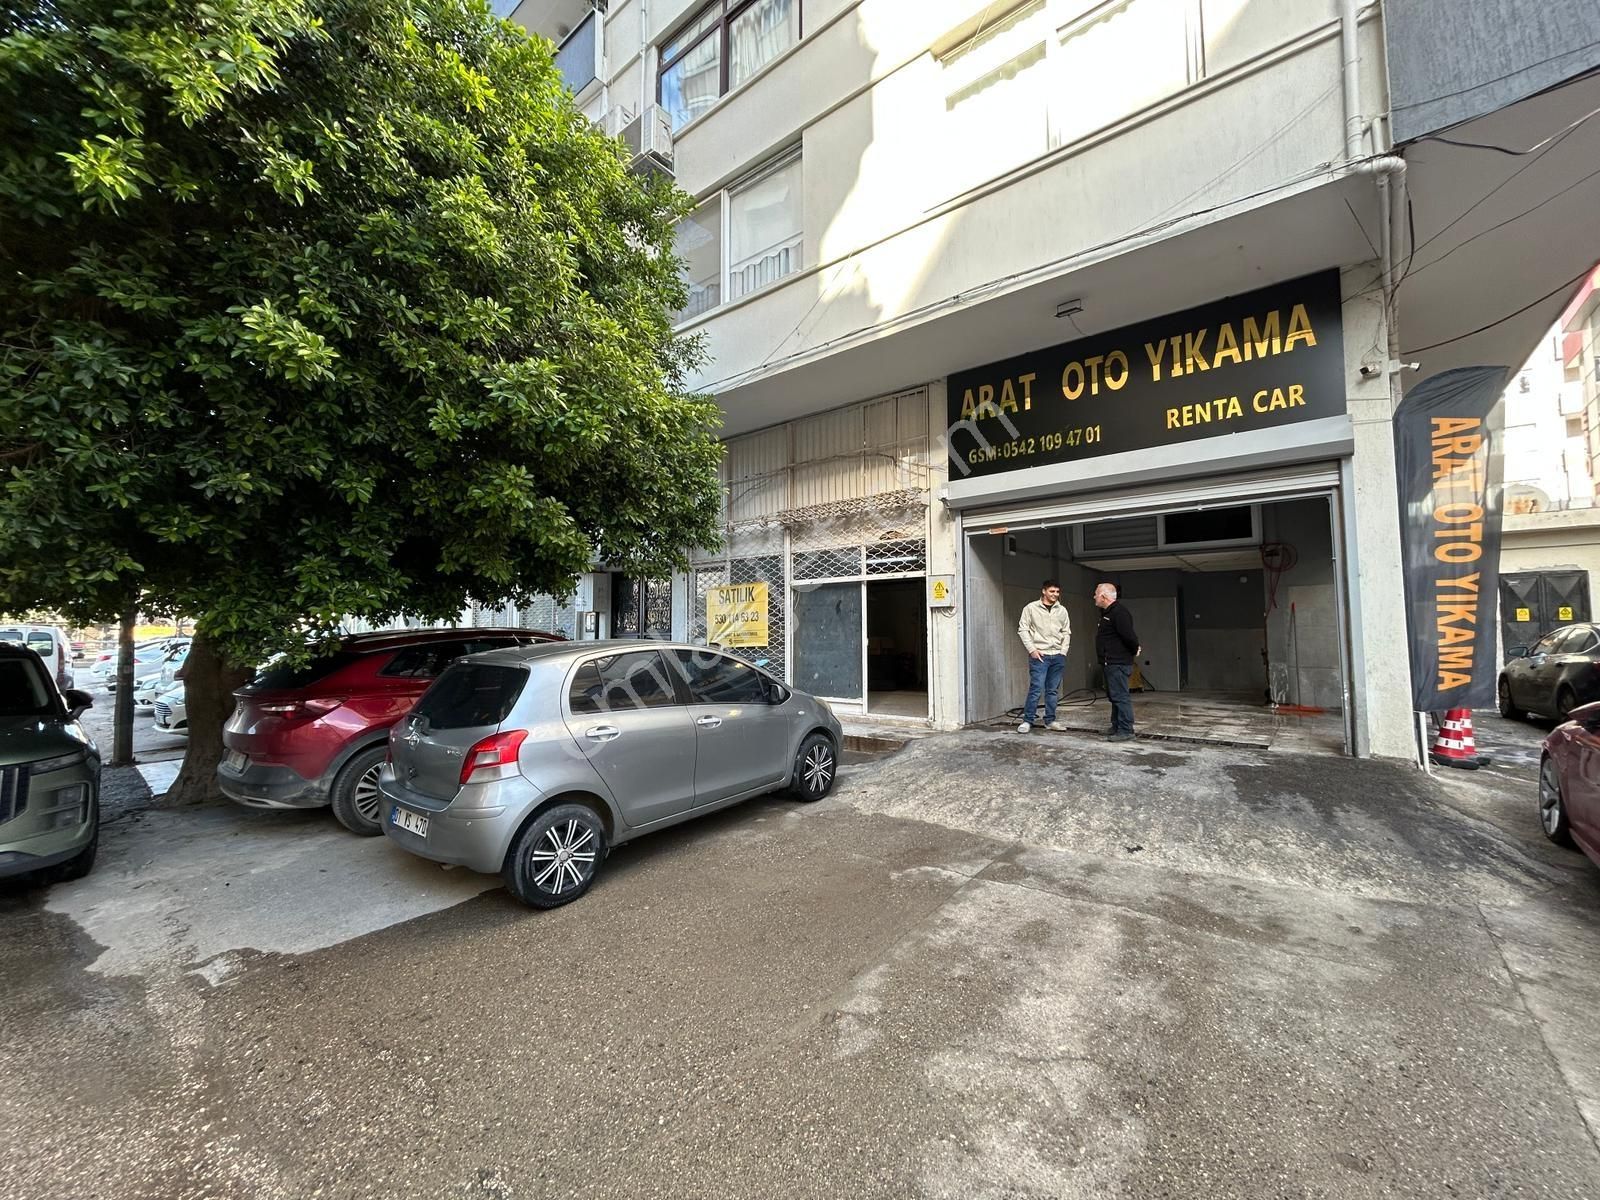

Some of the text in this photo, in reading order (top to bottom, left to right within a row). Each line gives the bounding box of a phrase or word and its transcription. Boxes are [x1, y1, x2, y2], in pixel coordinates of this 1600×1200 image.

[960, 303, 1318, 421] ARAT OTO YIKAMA
[1166, 383, 1306, 430] RENTA CAR
[1040, 433, 1062, 452] 109
[1066, 429, 1082, 447] 47
[1085, 424, 1101, 444] 01
[1431, 417, 1484, 692] ARAT OTO YIKAMA
[719, 586, 755, 605] SATILIK
[750, 610, 760, 622] 23
